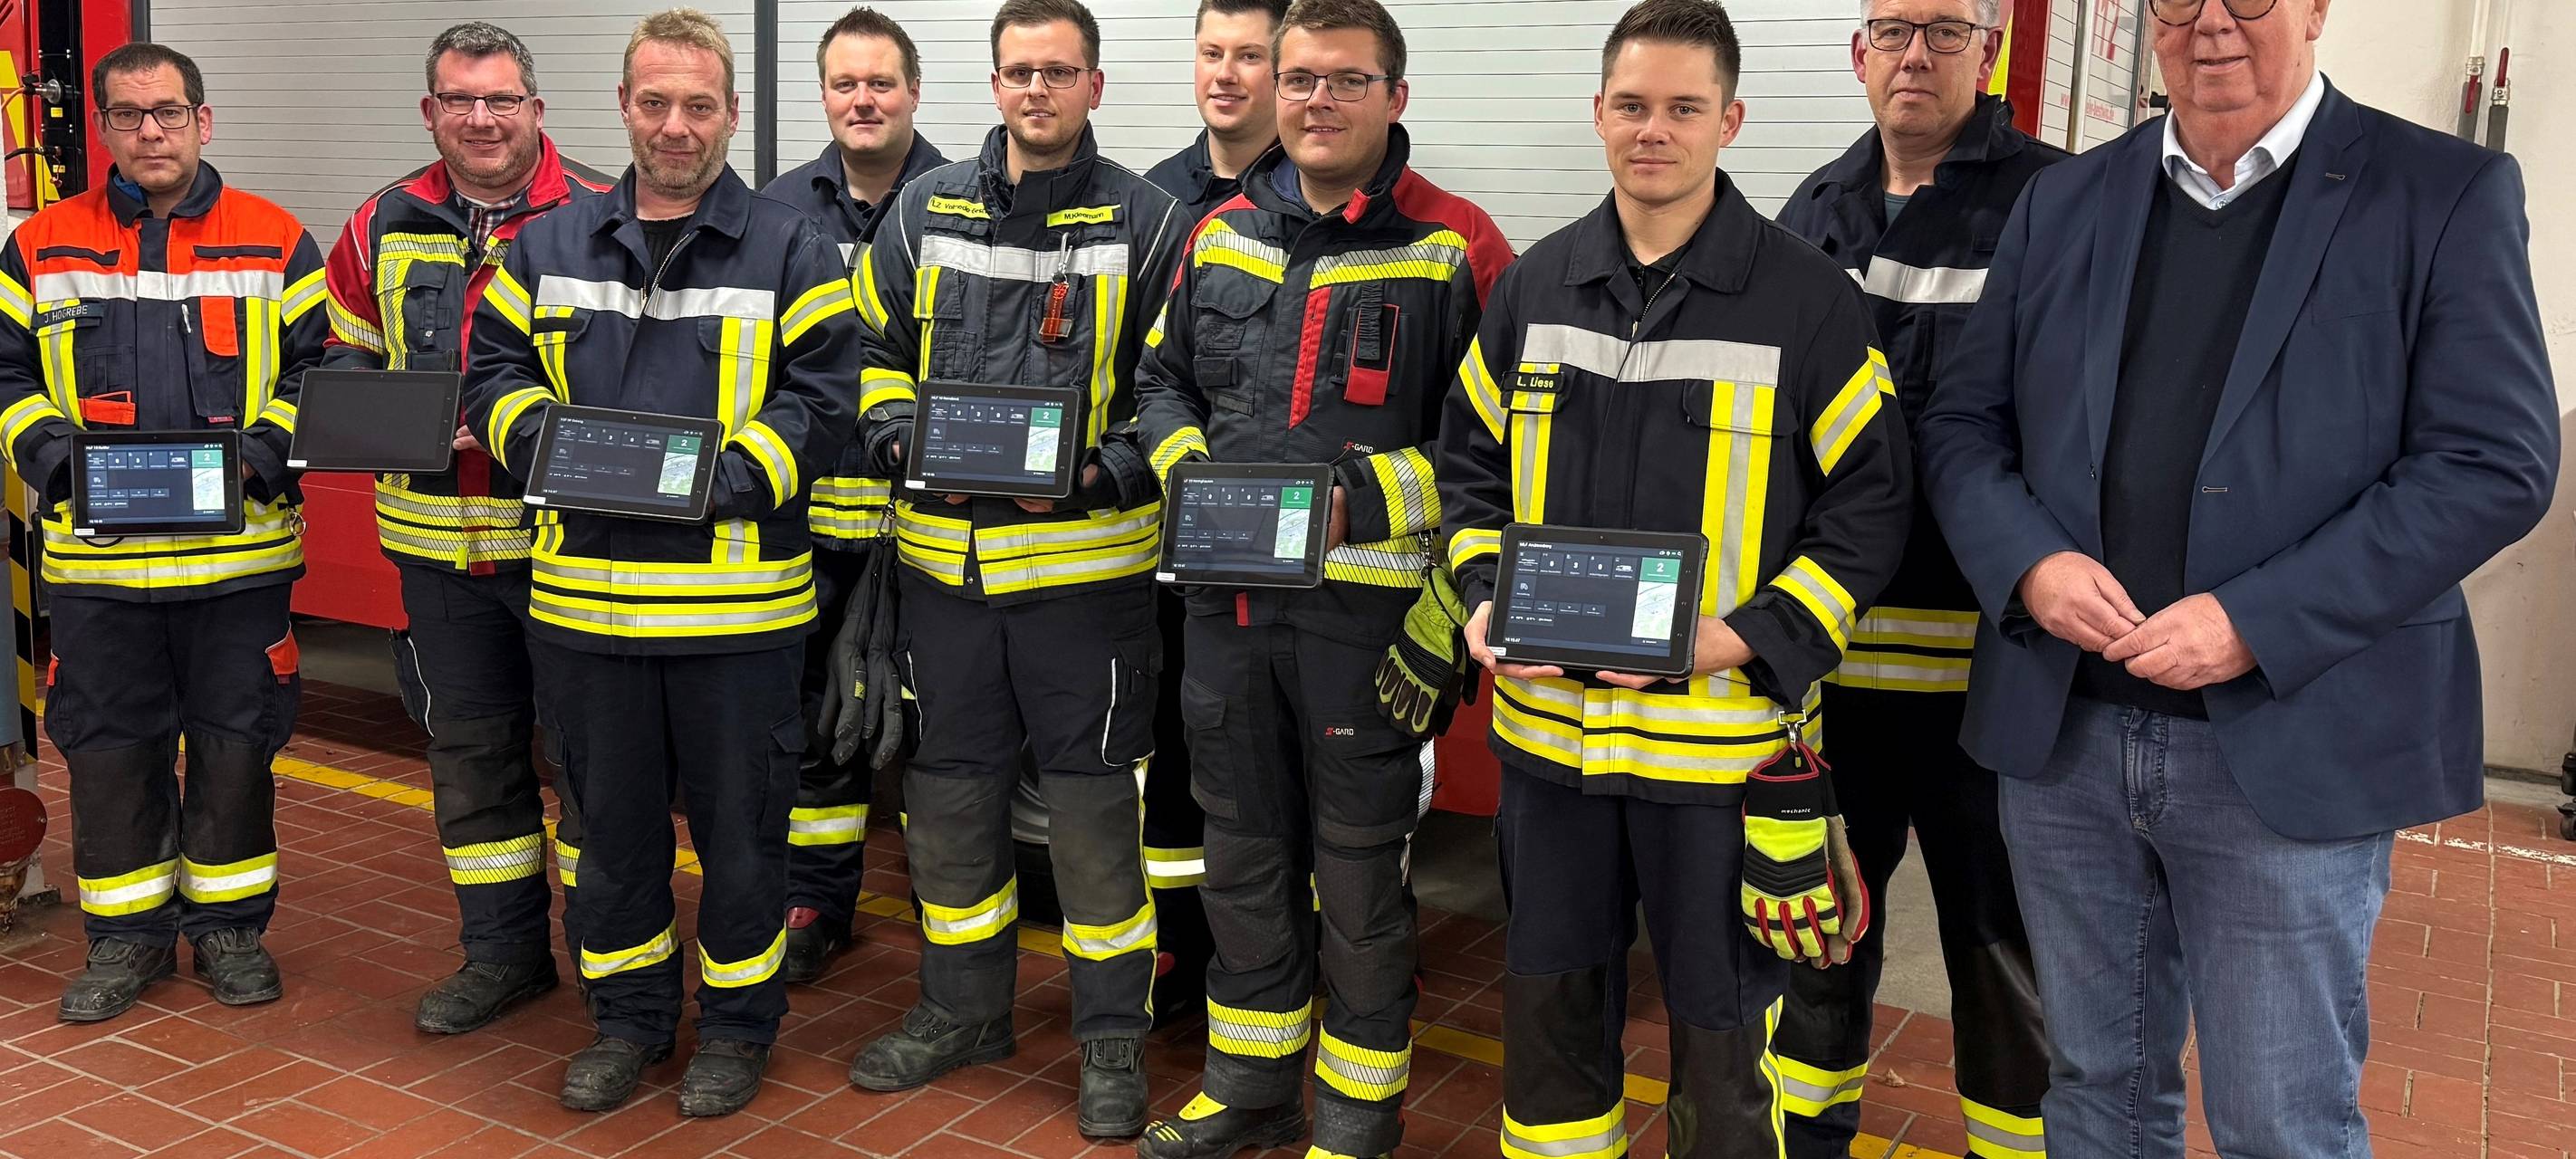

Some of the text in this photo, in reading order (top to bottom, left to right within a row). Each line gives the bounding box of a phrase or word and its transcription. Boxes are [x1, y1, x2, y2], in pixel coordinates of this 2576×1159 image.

[932, 200, 942, 208] LZ
[52, 305, 88, 321] HOGREBE
[1516, 376, 1554, 388] L. Liese
[1043, 411, 1050, 420] 2
[680, 439, 688, 447] 2
[204, 453, 211, 462] 2
[1293, 492, 1301, 500] 2
[1656, 562, 1665, 573] 2
[1325, 727, 1354, 736] S-GARD
